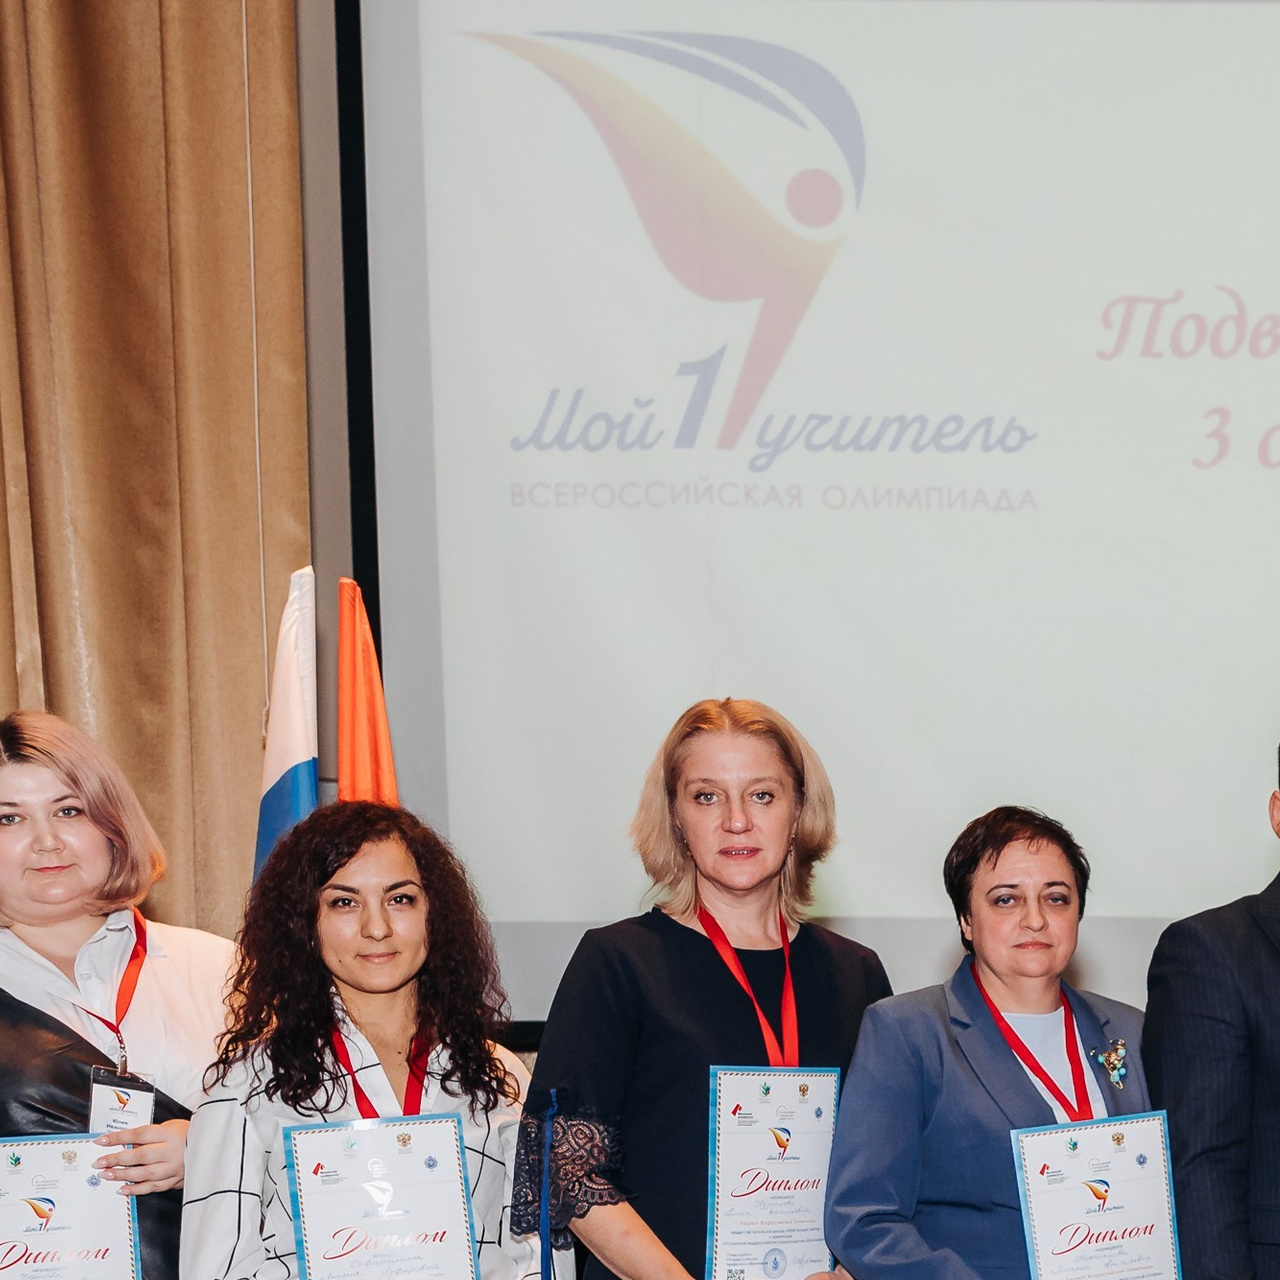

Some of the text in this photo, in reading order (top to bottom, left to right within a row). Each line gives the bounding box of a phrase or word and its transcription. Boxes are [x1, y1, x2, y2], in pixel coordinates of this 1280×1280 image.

[510, 387, 666, 453] Мой
[747, 411, 1039, 474] учитель
[1190, 405, 1233, 471] 3
[509, 477, 1039, 513] ВСЕРОССИЙСКАЯ ОЛИМПИАДА
[730, 1167, 823, 1198] Диплом
[322, 1226, 450, 1260] Диплом
[1051, 1223, 1157, 1256] Диплом
